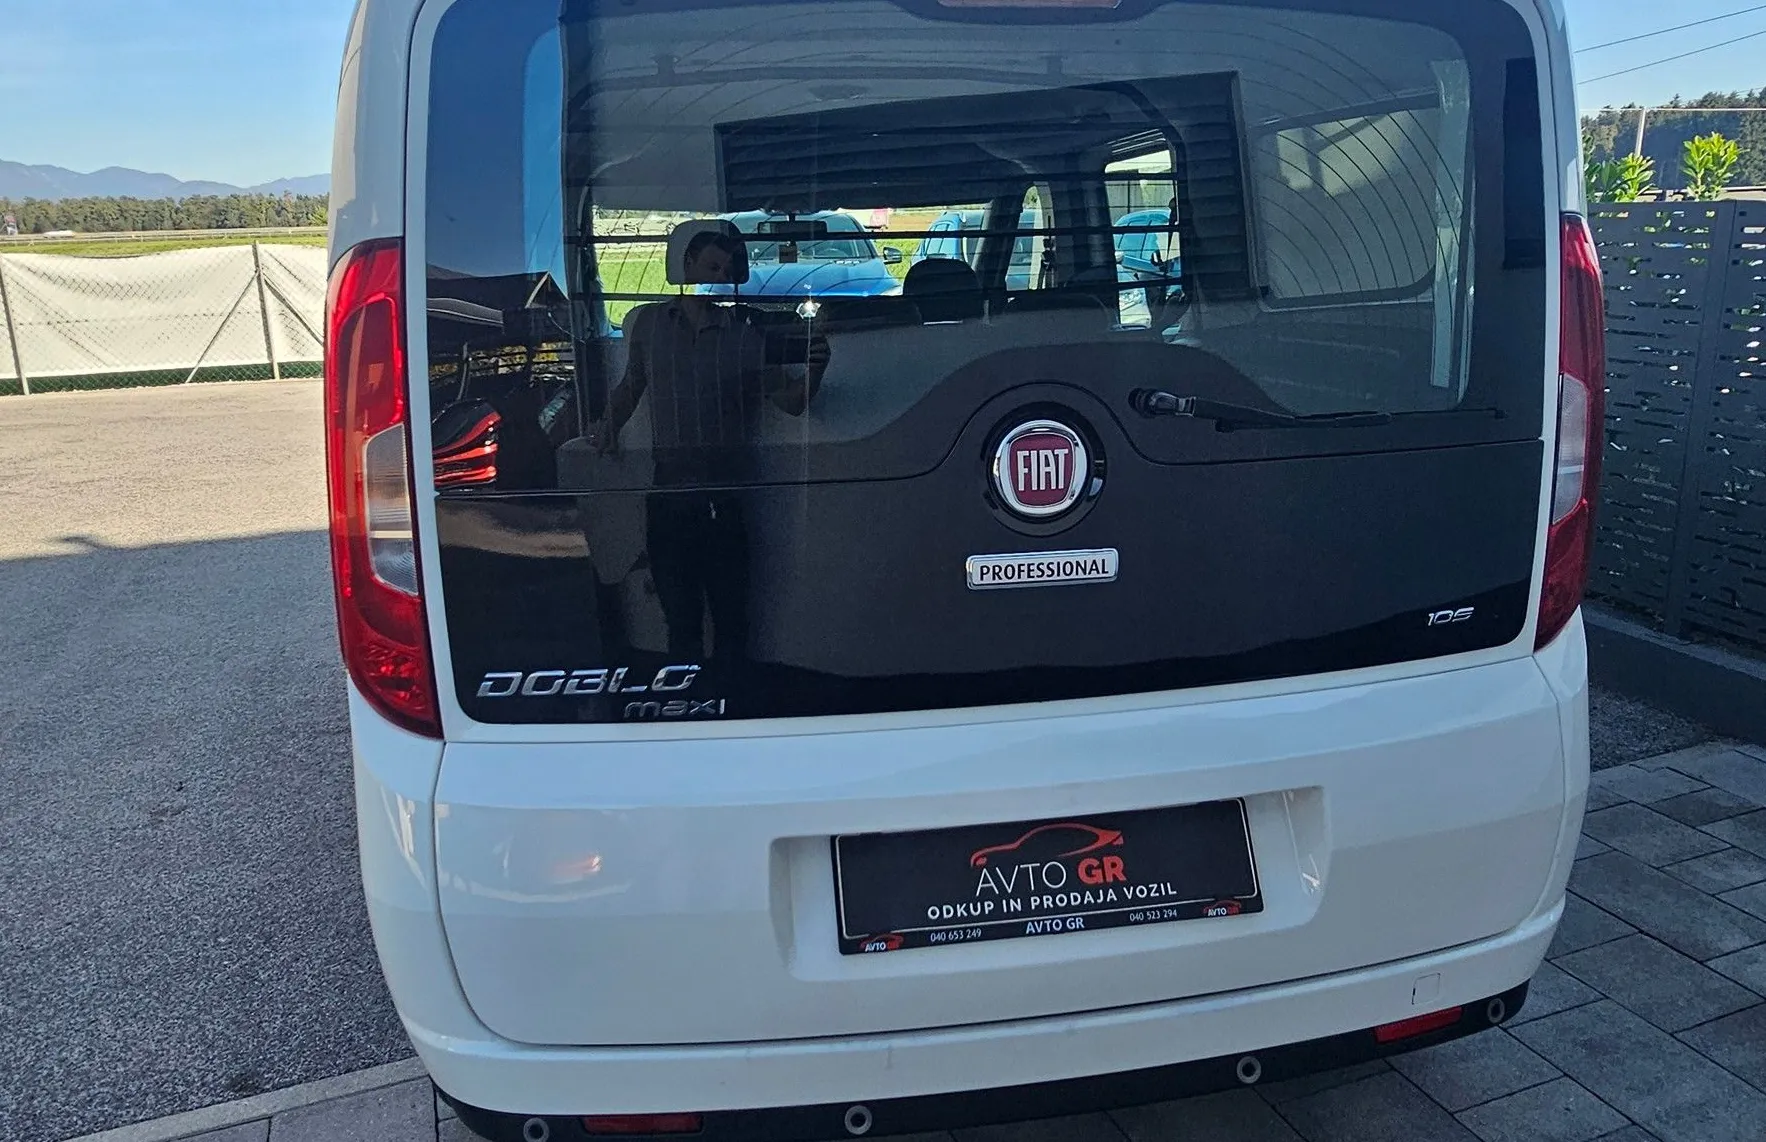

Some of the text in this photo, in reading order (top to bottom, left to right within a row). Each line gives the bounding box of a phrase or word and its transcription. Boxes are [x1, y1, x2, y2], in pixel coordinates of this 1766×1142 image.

[1016, 448, 1069, 491] FIAT
[979, 558, 1109, 581] PROFESSIONAL
[975, 855, 1126, 896] AVTO GR
[927, 882, 1178, 920] ODKUP IN PRODAJA VOZIL
[1129, 908, 1178, 922] 040 523 294
[1207, 907, 1227, 916] AVTO
[1025, 917, 1085, 934] AVTO GR
[930, 928, 982, 942] 040 653 249
[864, 941, 887, 952] AVTO
